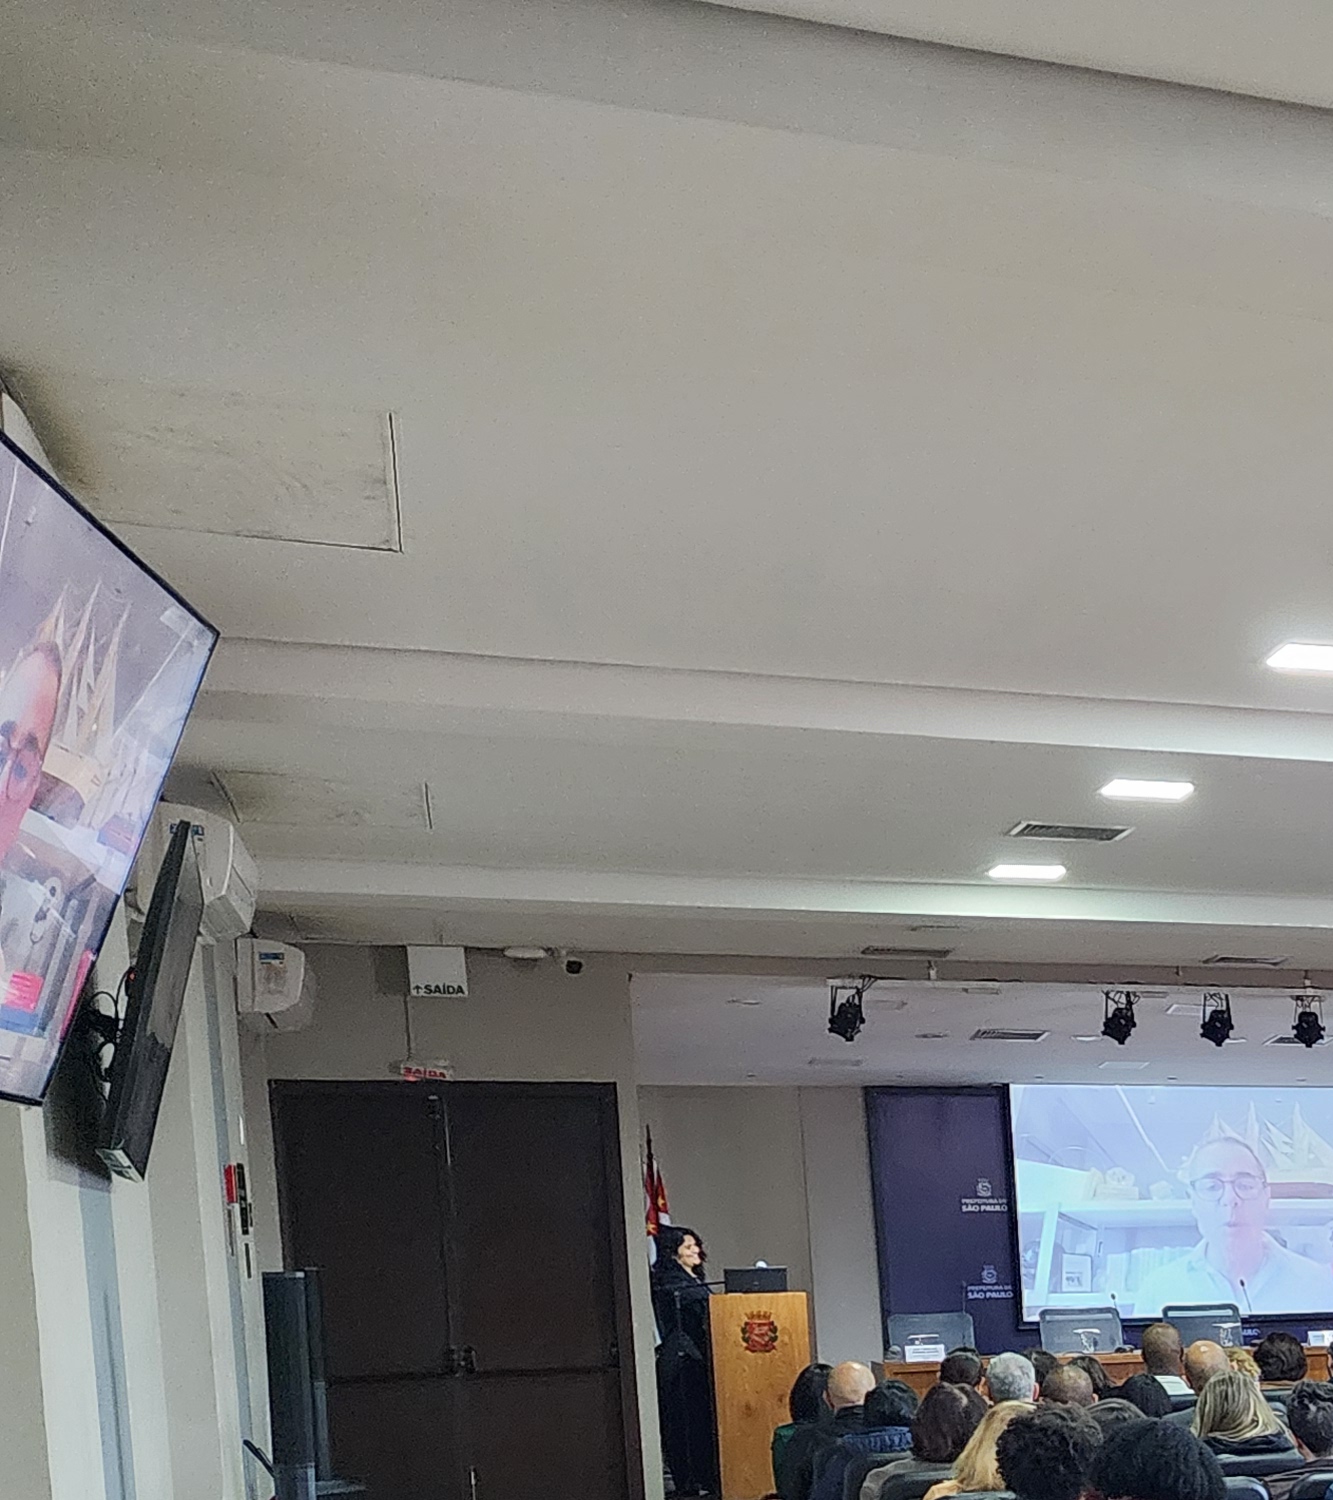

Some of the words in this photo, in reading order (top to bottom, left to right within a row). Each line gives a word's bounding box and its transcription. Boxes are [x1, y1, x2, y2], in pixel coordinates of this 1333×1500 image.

[423, 982, 466, 995] SAÍDA
[961, 1204, 980, 1212] SÃO
[980, 1204, 1008, 1212] PAULO
[967, 1291, 985, 1299] SÃO
[985, 1291, 1014, 1299] PAULO
